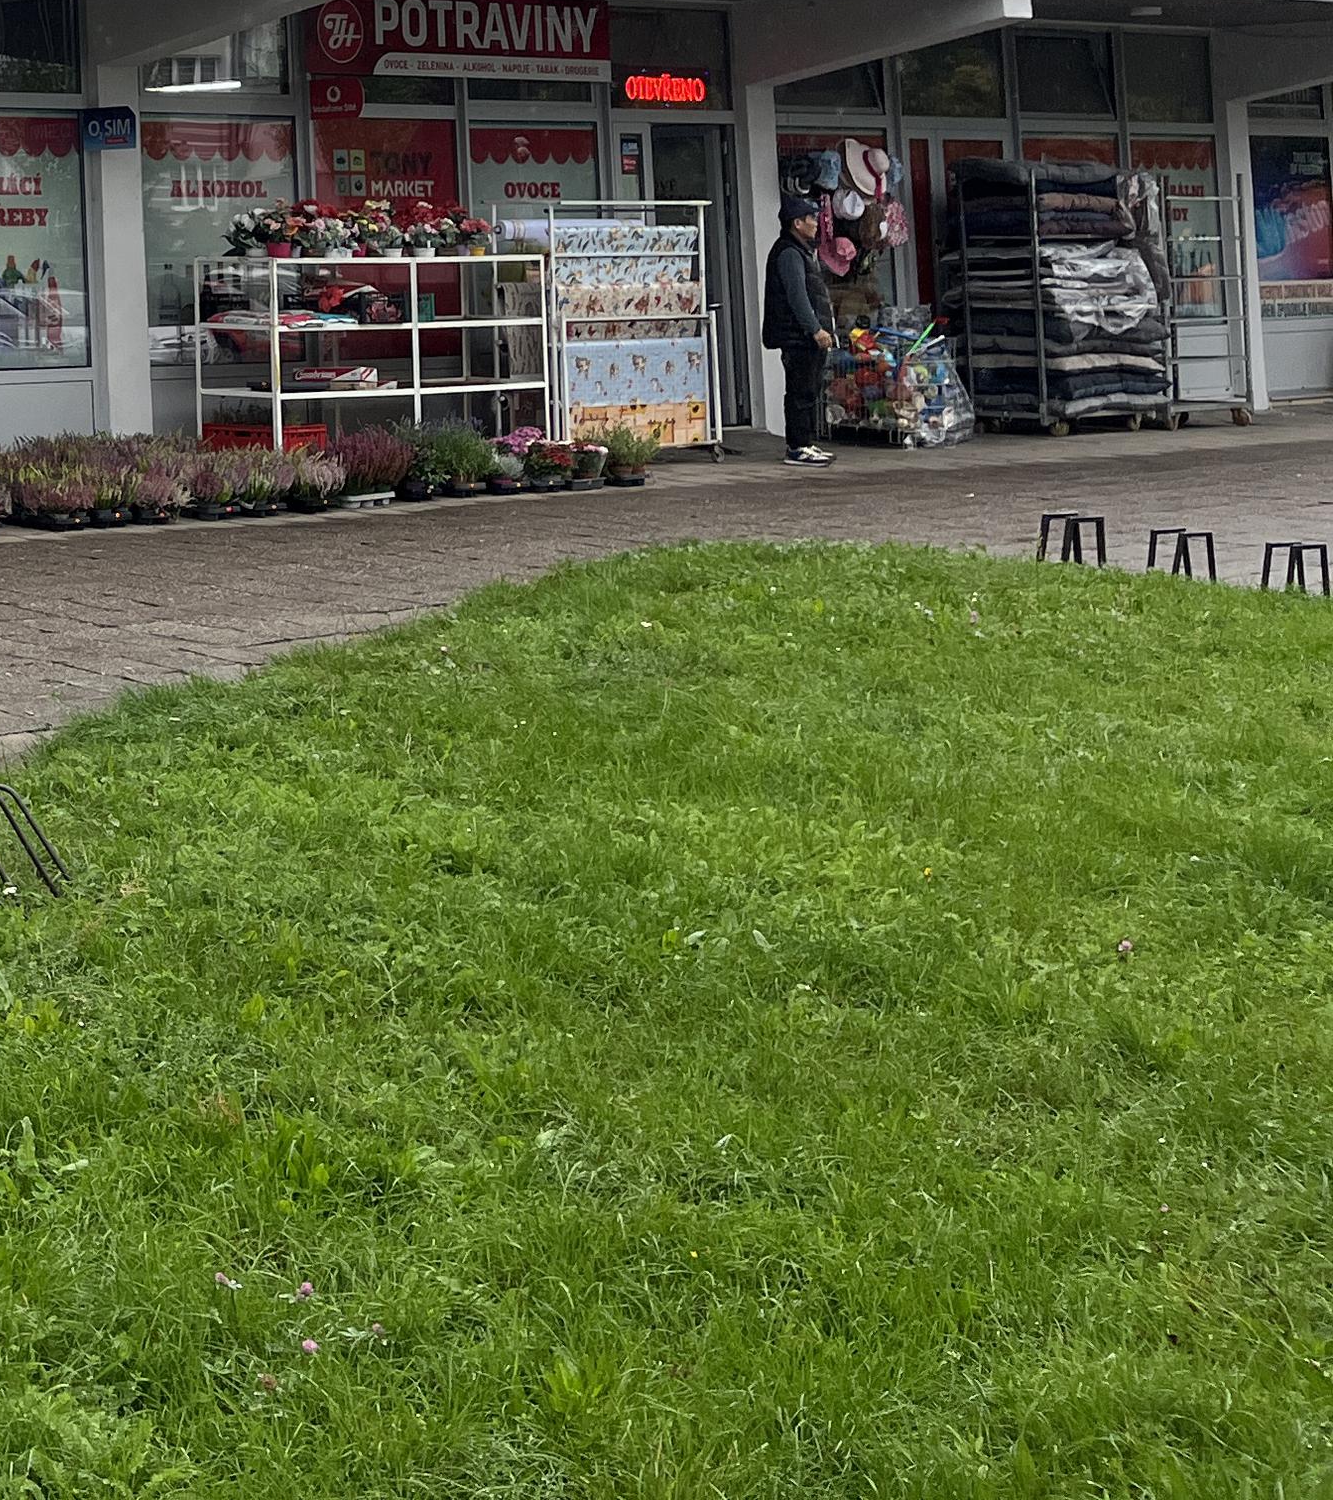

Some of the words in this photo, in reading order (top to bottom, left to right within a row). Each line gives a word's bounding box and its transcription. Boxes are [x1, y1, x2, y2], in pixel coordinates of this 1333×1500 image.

[384, 59, 409, 70] OVOCE
[417, 60, 455, 72] ZELENINA
[463, 62, 497, 73] ALKOHOL
[565, 65, 600, 77] DROGERIE
[104, 118, 131, 137] SIM
[170, 180, 268, 198] ALKOHOL
[371, 180, 435, 197] MARKET
[504, 181, 561, 199] OVOCE
